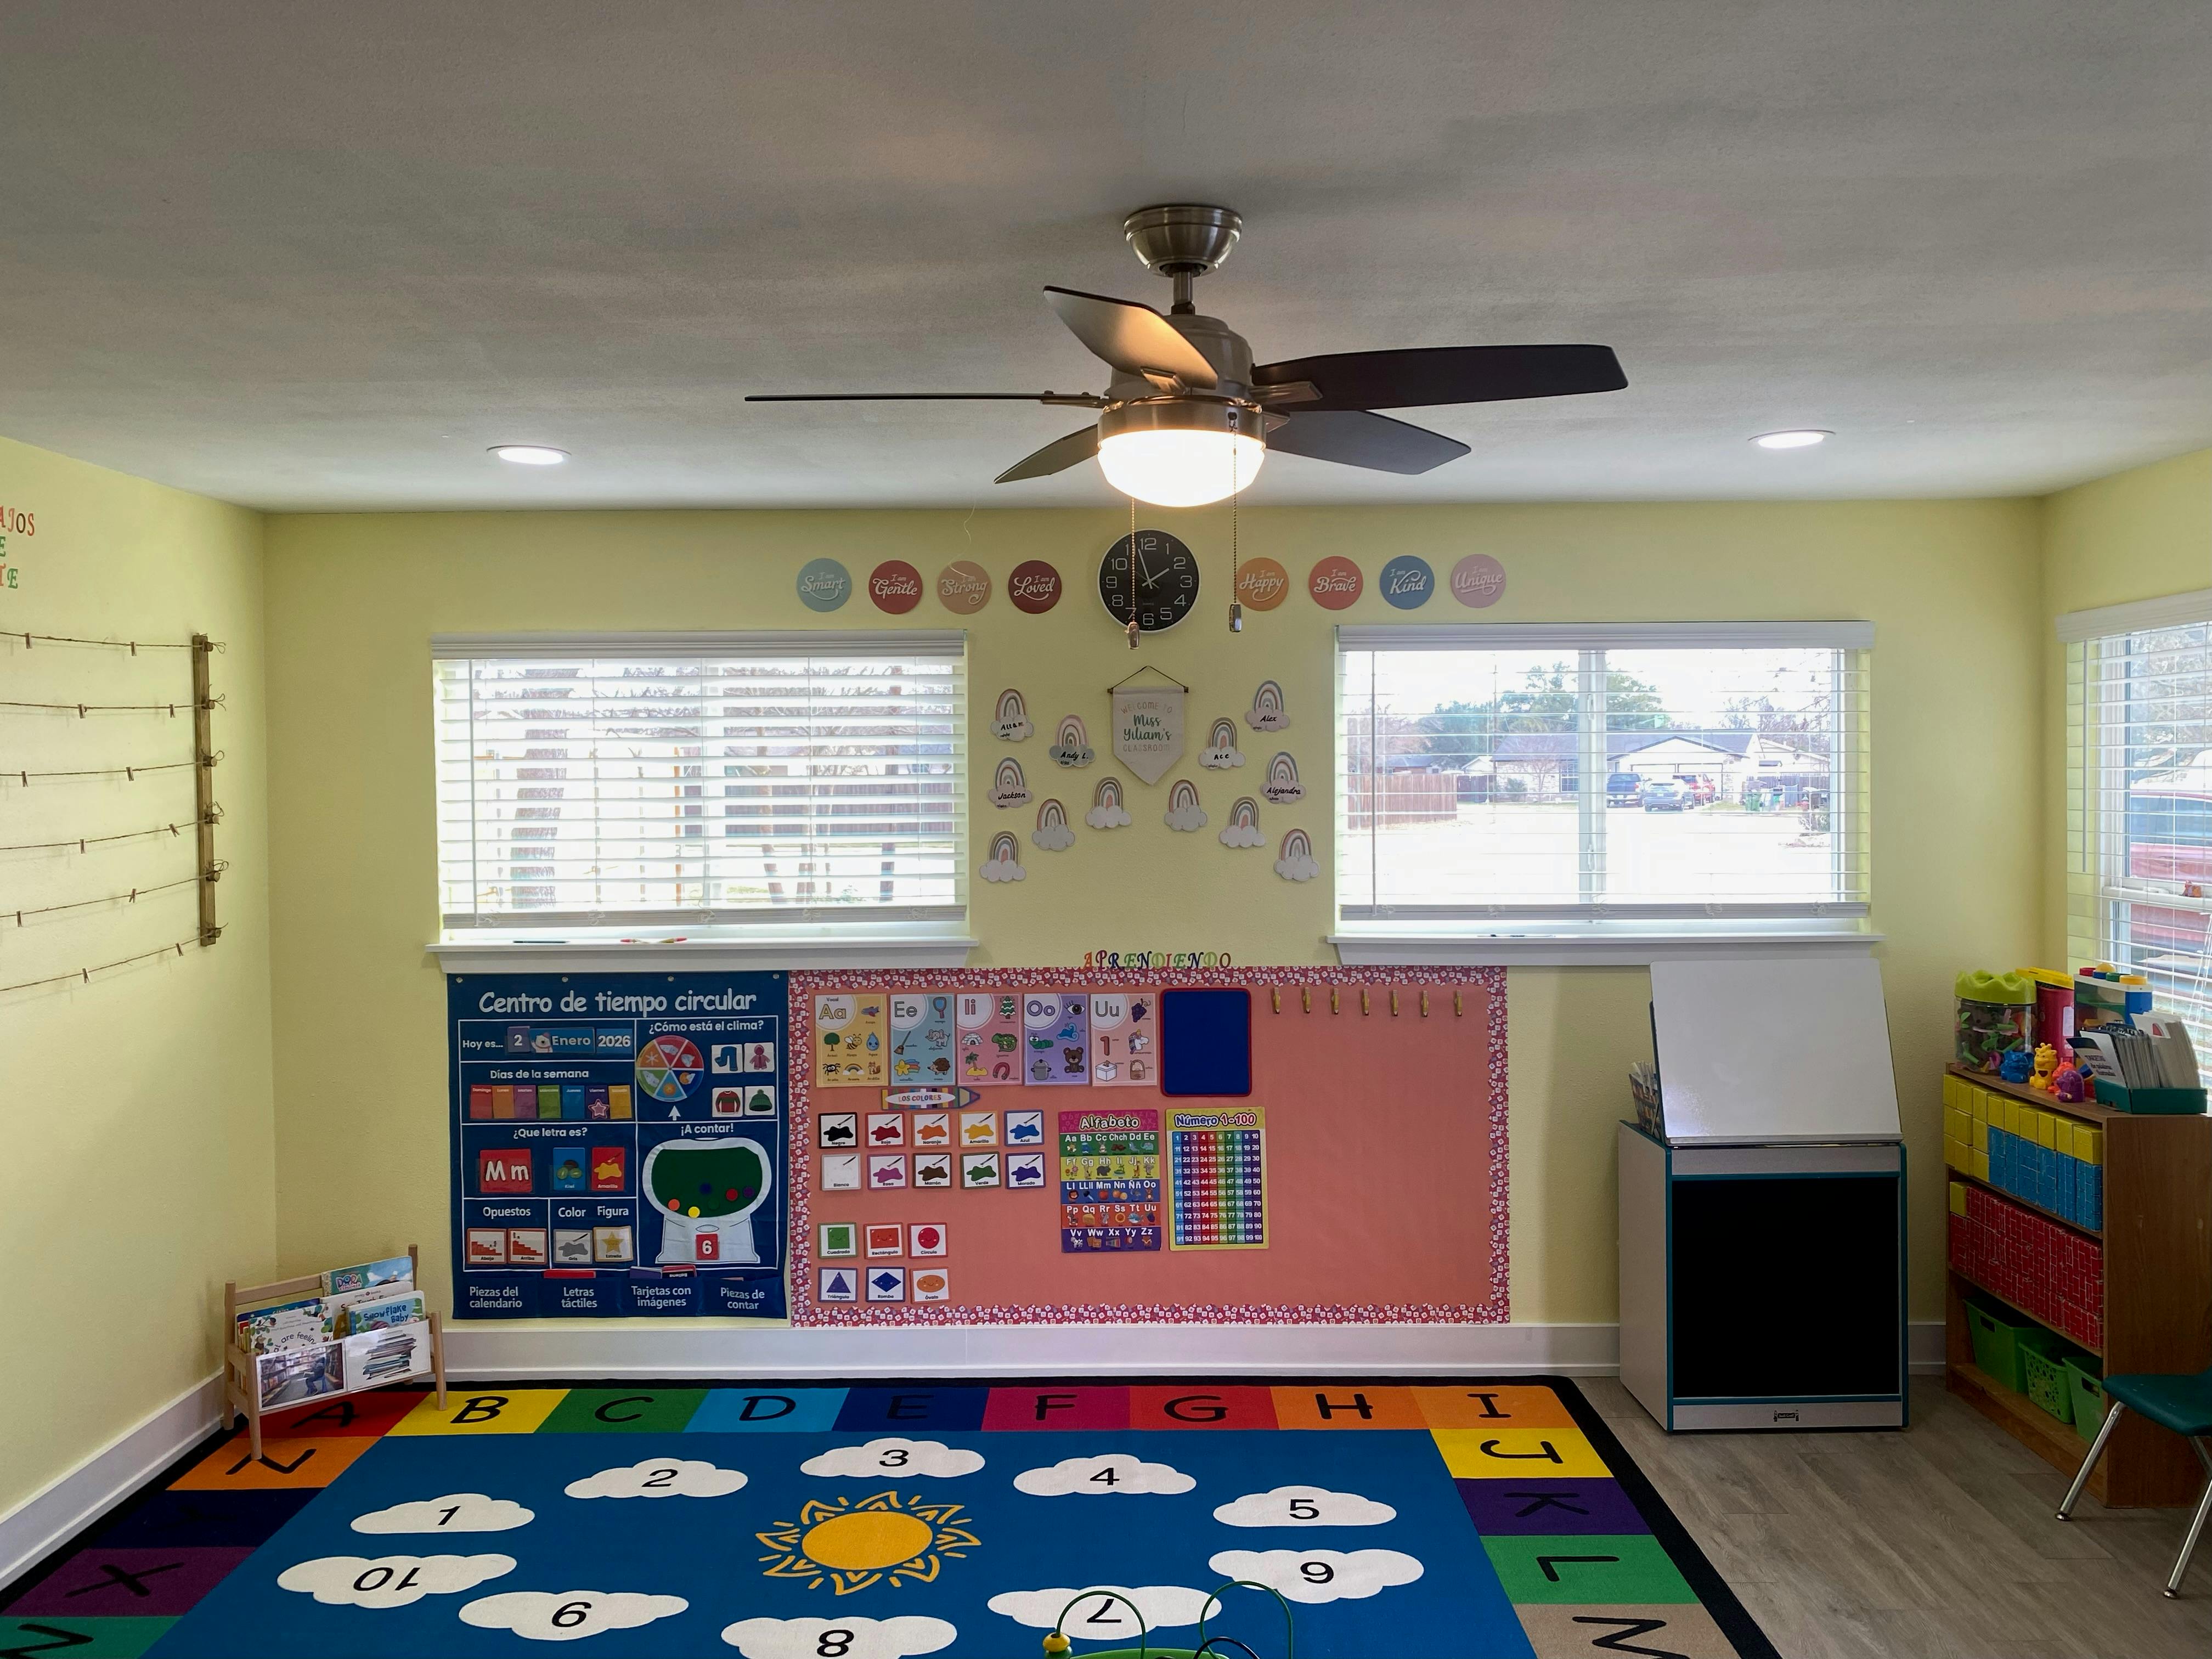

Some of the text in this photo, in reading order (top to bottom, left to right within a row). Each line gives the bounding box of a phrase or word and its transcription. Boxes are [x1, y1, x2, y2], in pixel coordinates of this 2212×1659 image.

[1140, 538, 1156, 550] 12
[1166, 543, 1170, 555] 1
[1111, 558, 1127, 570] 10
[1173, 557, 1186, 569] 2
[801, 575, 846, 600] Smart
[1106, 577, 1117, 588] 9
[1180, 575, 1192, 588] 3
[1239, 574, 1284, 601] Happy
[1314, 577, 1356, 592] Brave
[1390, 570, 1426, 594] Kind
[1455, 572, 1503, 595] Unique
[873, 579, 917, 599] Gentle
[941, 579, 988, 605] Strong
[1014, 577, 1055, 600] Loved
[1112, 595, 1124, 606] 8
[1174, 594, 1187, 606] 4
[1125, 607, 1137, 620] 7
[1143, 613, 1154, 625] 6
[1160, 607, 1172, 620] 5
[1120, 702, 1159, 714] WELCOME
[1133, 714, 1161, 726] Miss
[1060, 751, 1080, 761] Andy
[998, 792, 1026, 800] Jackson
[1267, 786, 1301, 795] Alejandra
[1083, 949, 1232, 970] APRENDIENDO
[479, 988, 757, 1018] Centro de tiempo circular
[894, 1001, 917, 1017] Ee
[1027, 1000, 1056, 1017] Oo
[1095, 1001, 1119, 1017] Uu
[819, 1003, 847, 1019] Aa
[648, 1020, 764, 1034] ¿Cómo está el clima?
[462, 1040, 482, 1050] Hoy
[514, 1034, 522, 1046] 2
[552, 1036, 591, 1046] Enero
[597, 1035, 631, 1047] 2026
[490, 1069, 589, 1079] Días de la semana
[1080, 1114, 1139, 1129] Alfabeto
[1175, 1114, 1218, 1127] Número
[513, 1127, 588, 1139] ¿Que letra es?
[681, 1124, 733, 1136] ¡A contar!
[1096, 1133, 1107, 1141] Cc
[1109, 1133, 1127, 1141] Chch
[1130, 1133, 1141, 1141] Dd
[1114, 1181, 1125, 1189] Nn
[1143, 1180, 1156, 1188] Oo
[483, 1206, 531, 1219] Opuestos
[558, 1205, 629, 1218] Color Figura
[702, 1240, 712, 1254] 6
[336, 1274, 363, 1288] DORA
[469, 1286, 518, 1297] Piezas del
[563, 1287, 594, 1297] Letras
[631, 1285, 691, 1298] Tarjetas con
[720, 1288, 765, 1299] Piezas de
[469, 1298, 522, 1308] calendario
[561, 1298, 597, 1308] táctiles
[637, 1297, 686, 1308] imágenes
[727, 1300, 759, 1310] contar
[364, 1305, 407, 1321] Snowflake
[391, 1313, 409, 1323] Baby
[281, 1332, 317, 1344] are feelin
[452, 1396, 510, 1424] B
[595, 1397, 654, 1423] C
[738, 1395, 797, 1421] D
[887, 1394, 935, 1421] E
[1035, 1394, 1077, 1421] F
[1163, 1395, 1230, 1420] G
[1315, 1393, 1373, 1420] H
[1466, 1393, 1513, 1418] I
[290, 1401, 360, 1429] A
[878, 1449, 909, 1468] 3
[1480, 1440, 1565, 1464] J
[642, 1469, 678, 1488] 2
[1089, 1467, 1120, 1486] 4
[1288, 1499, 1319, 1519] 5
[1503, 1493, 1590, 1517] K
[438, 1506, 462, 1527] 1
[66, 1564, 184, 1598] X
[816, 1629, 855, 1657] 8
